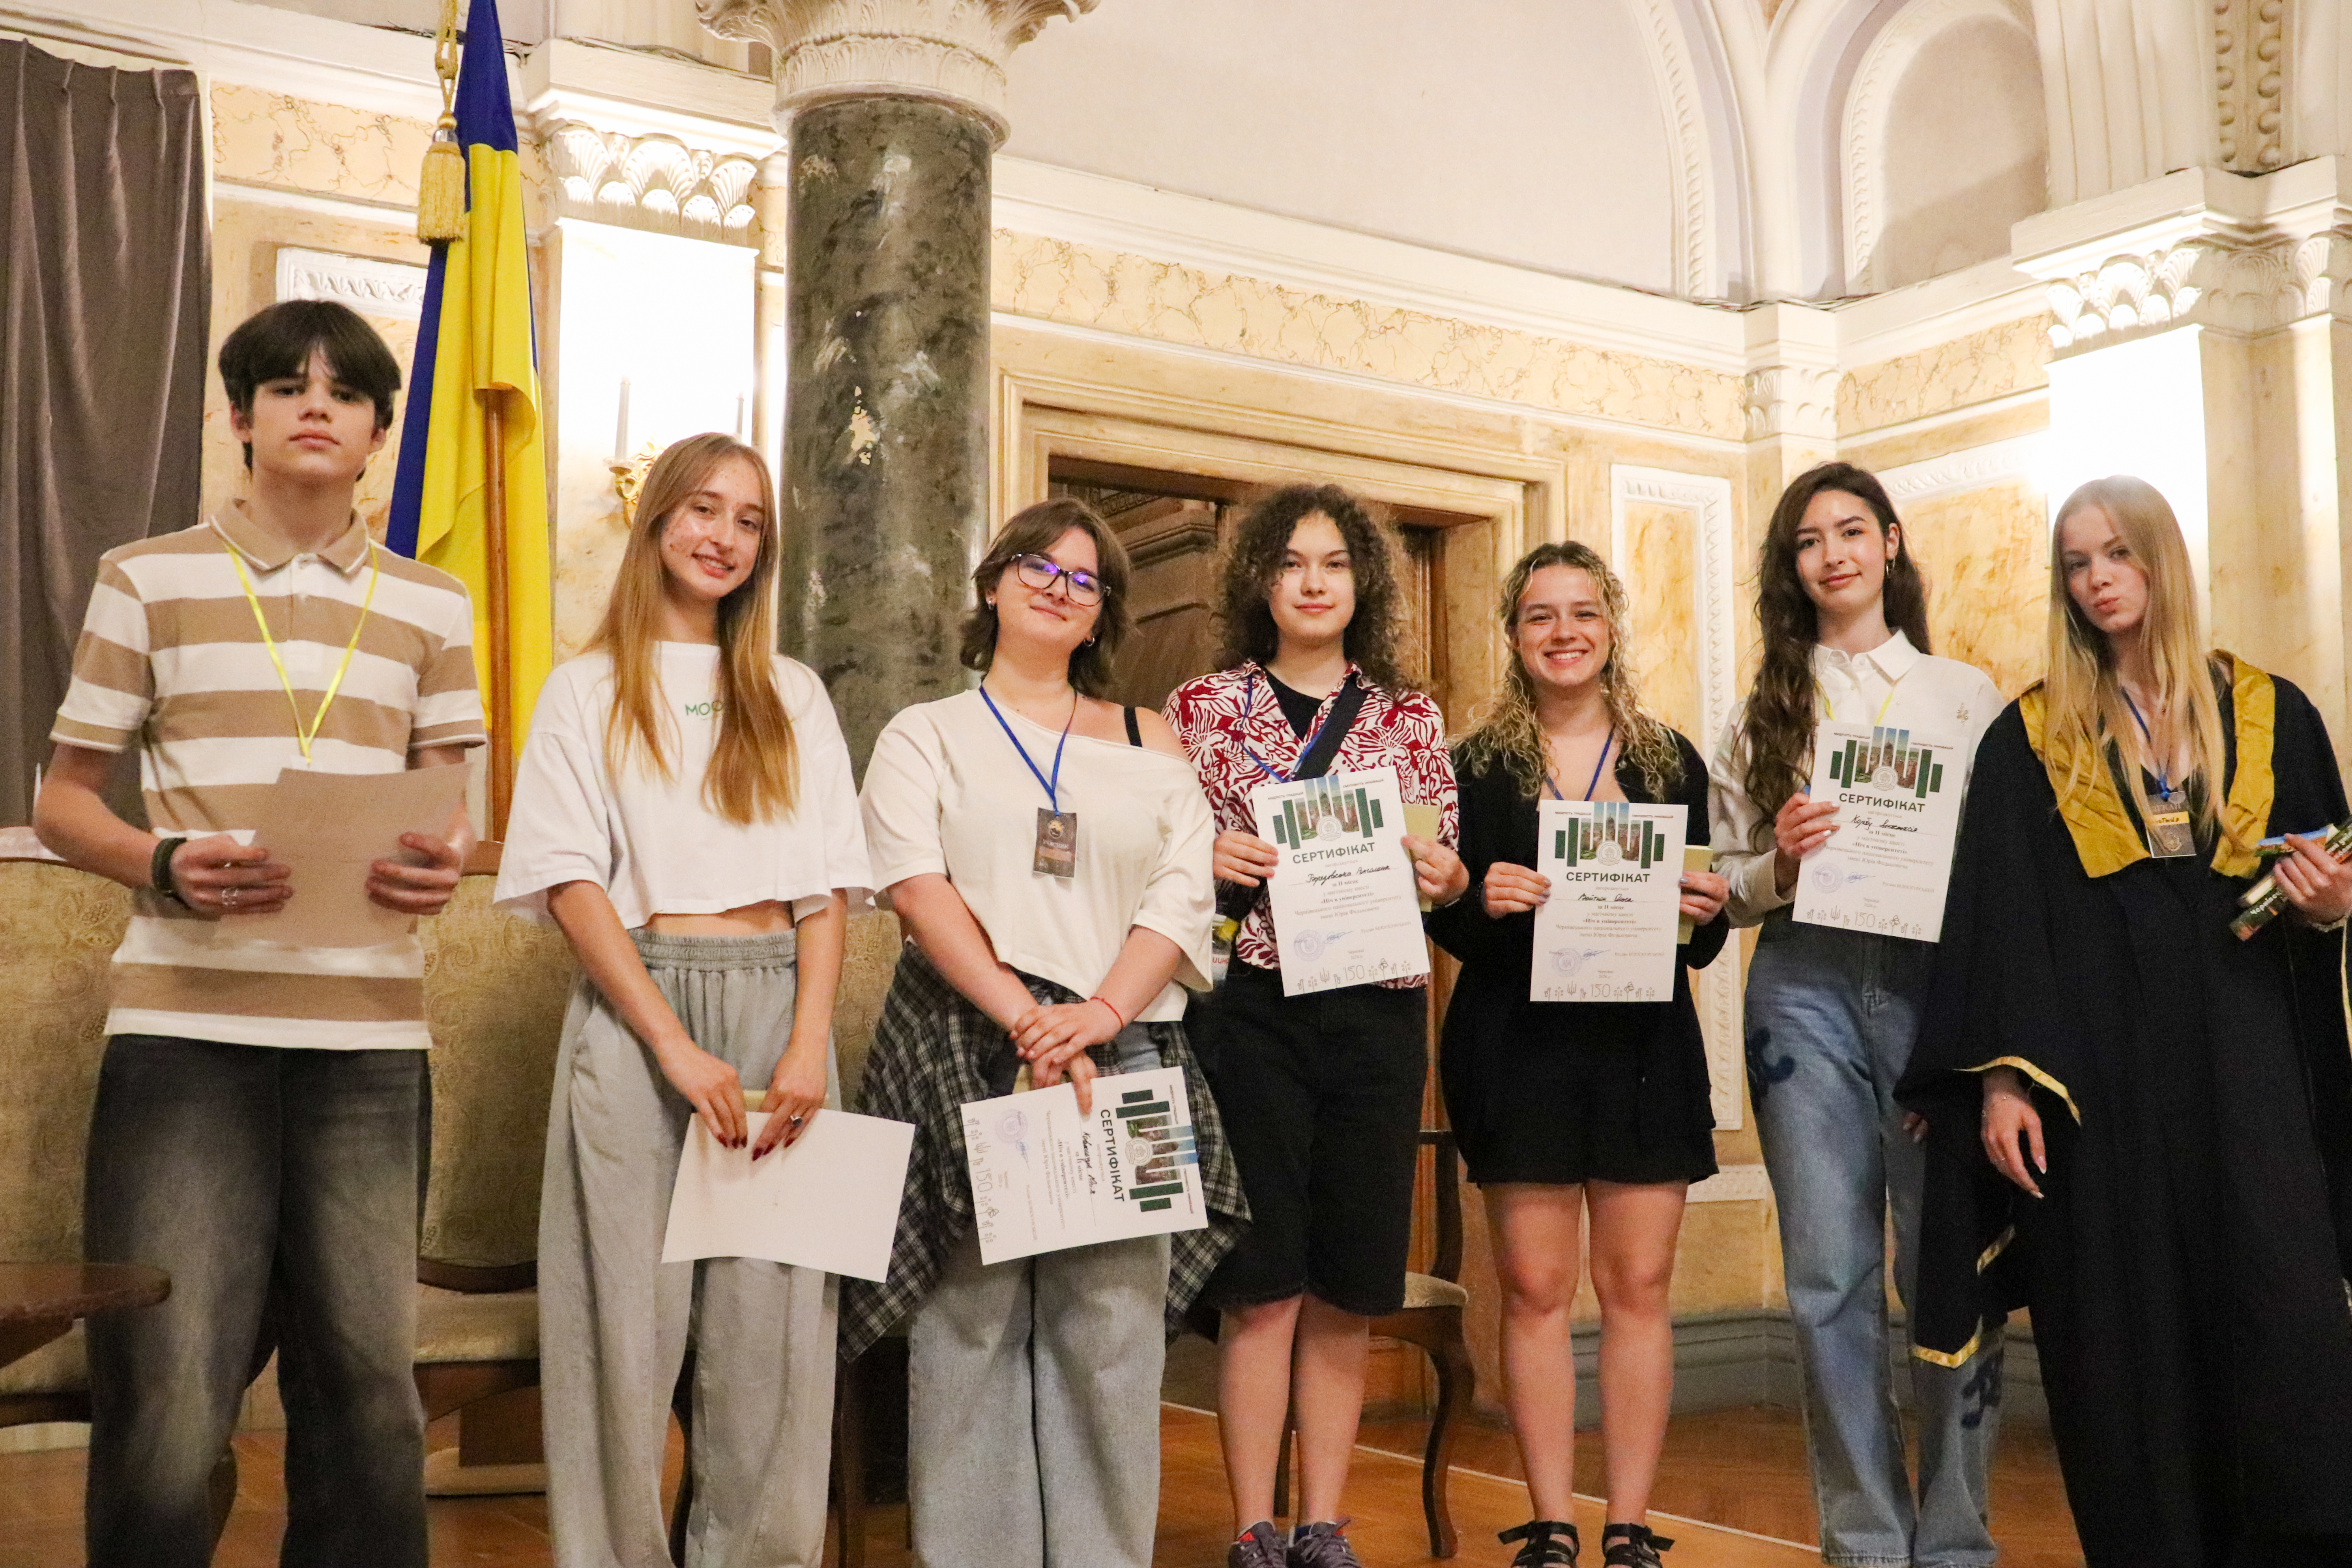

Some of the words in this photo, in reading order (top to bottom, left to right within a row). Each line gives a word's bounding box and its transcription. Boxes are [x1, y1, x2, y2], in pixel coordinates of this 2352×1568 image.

[1838, 793, 1925, 813] СЕРТИФІКАТ
[1292, 842, 1376, 864] СЕРТИФІКАТ
[1566, 872, 1650, 883] СЕРТИФІКАТ
[1853, 911, 1876, 928] 150
[1343, 964, 1365, 982] 150
[1590, 984, 1611, 997] 150
[1100, 1108, 1125, 1203] СЕРТИФІКАТ
[975, 1168, 993, 1192] 150
